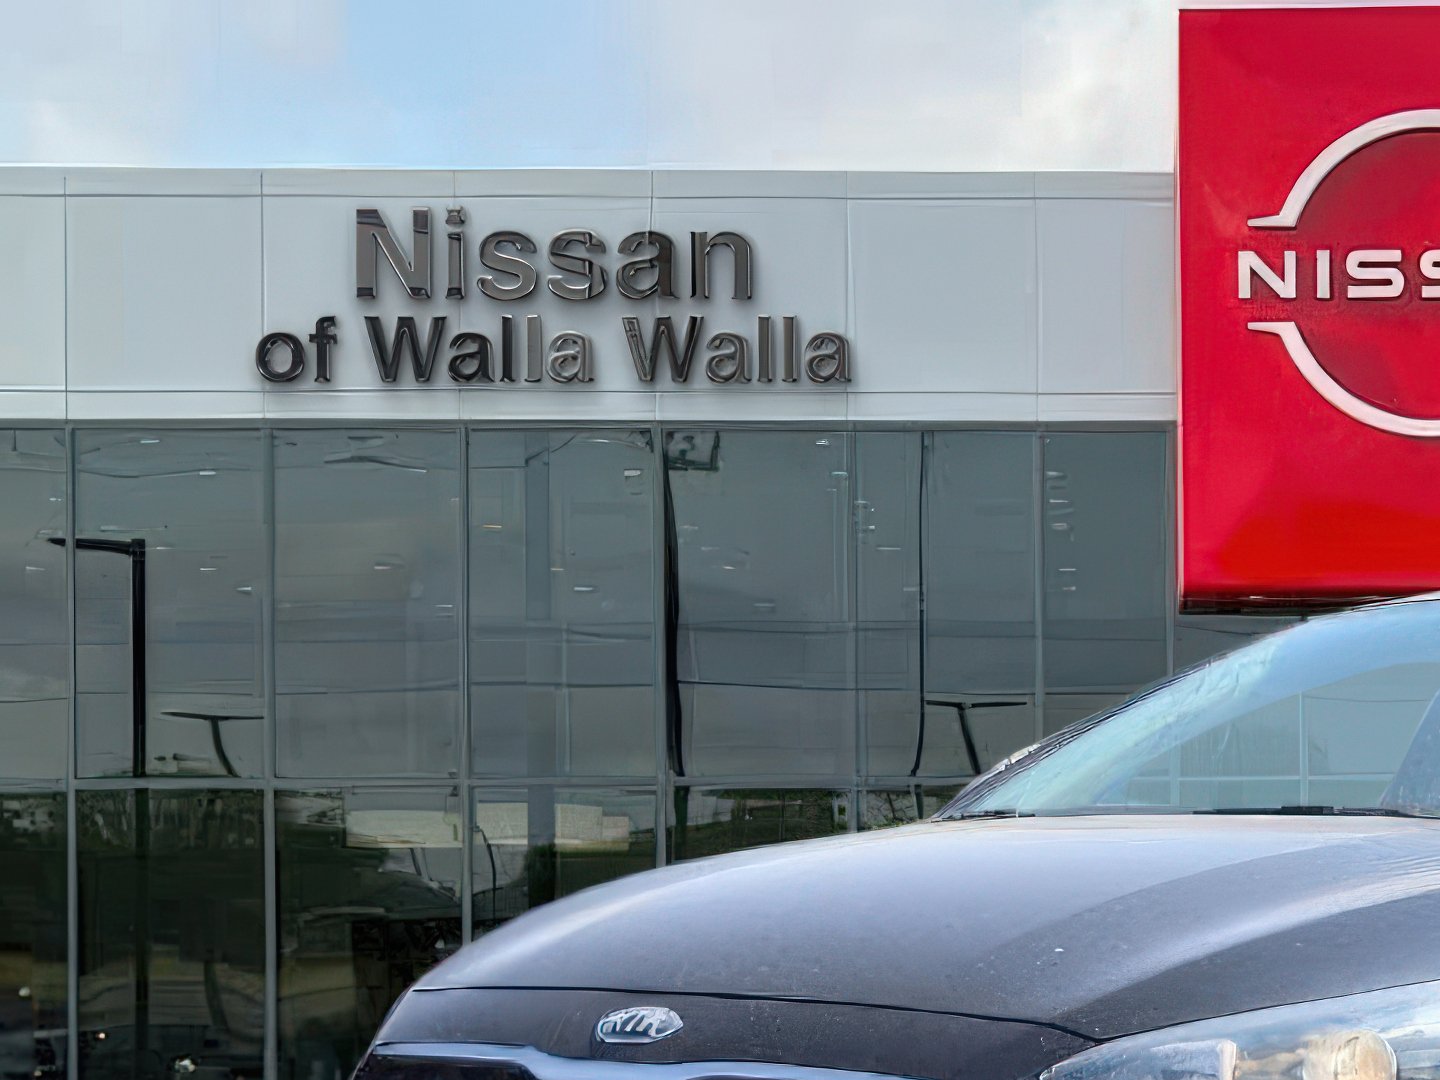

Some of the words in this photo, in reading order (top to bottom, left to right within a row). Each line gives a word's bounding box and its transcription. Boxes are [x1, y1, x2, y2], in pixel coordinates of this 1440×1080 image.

[355, 205, 754, 300] Nissan
[254, 314, 339, 384] of
[363, 314, 595, 384] Walla
[621, 314, 853, 384] Walla
